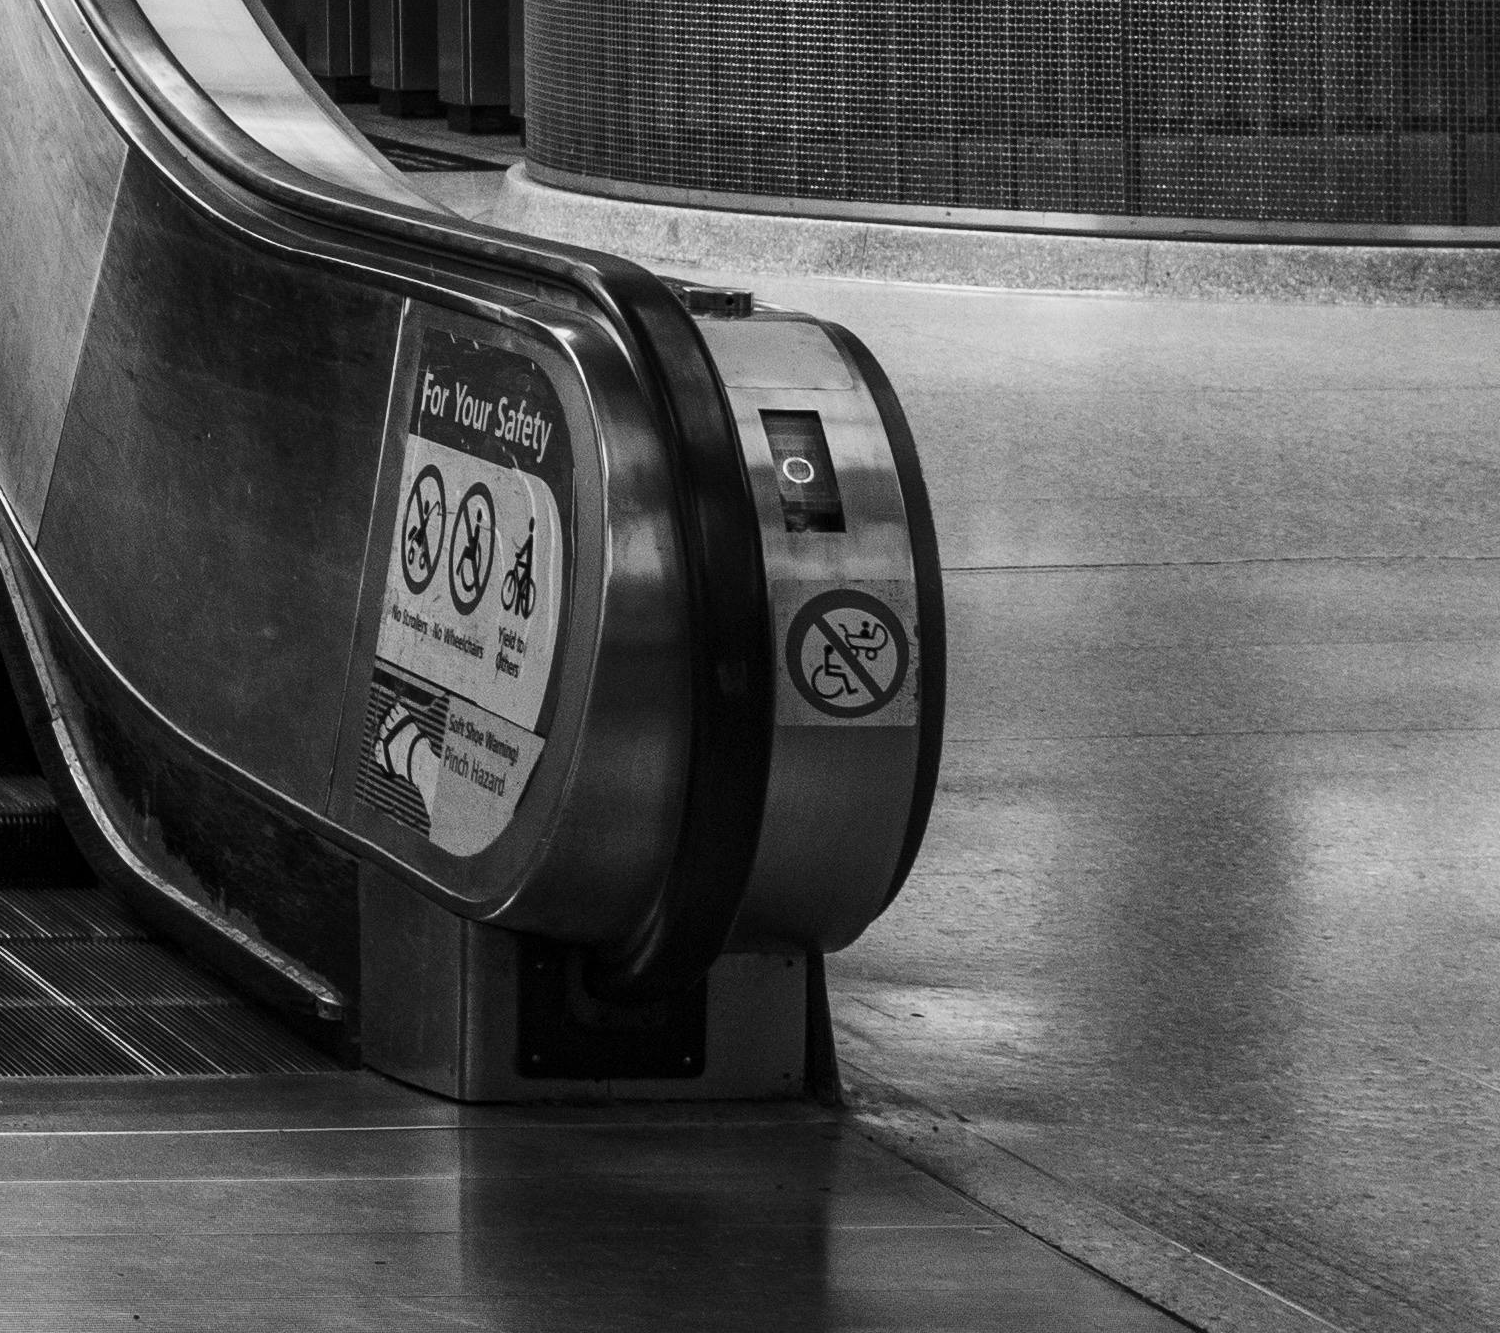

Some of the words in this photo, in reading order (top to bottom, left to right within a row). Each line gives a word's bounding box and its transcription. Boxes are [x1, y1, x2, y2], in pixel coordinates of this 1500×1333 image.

[421, 373, 450, 417] For
[455, 382, 493, 432] Your
[494, 397, 552, 463] Safety
[391, 604, 401, 622] No
[402, 608, 428, 635] Strollers
[432, 622, 443, 641] No
[443, 626, 484, 659] Wheelchairs
[499, 625, 517, 651] Yield
[517, 635, 526, 654] to
[495, 652, 519, 679] Others
[449, 713, 465, 737] Soft
[465, 721, 485, 747] Shoe
[443, 745, 469, 779] Pinch
[470, 757, 507, 798] Hazard
